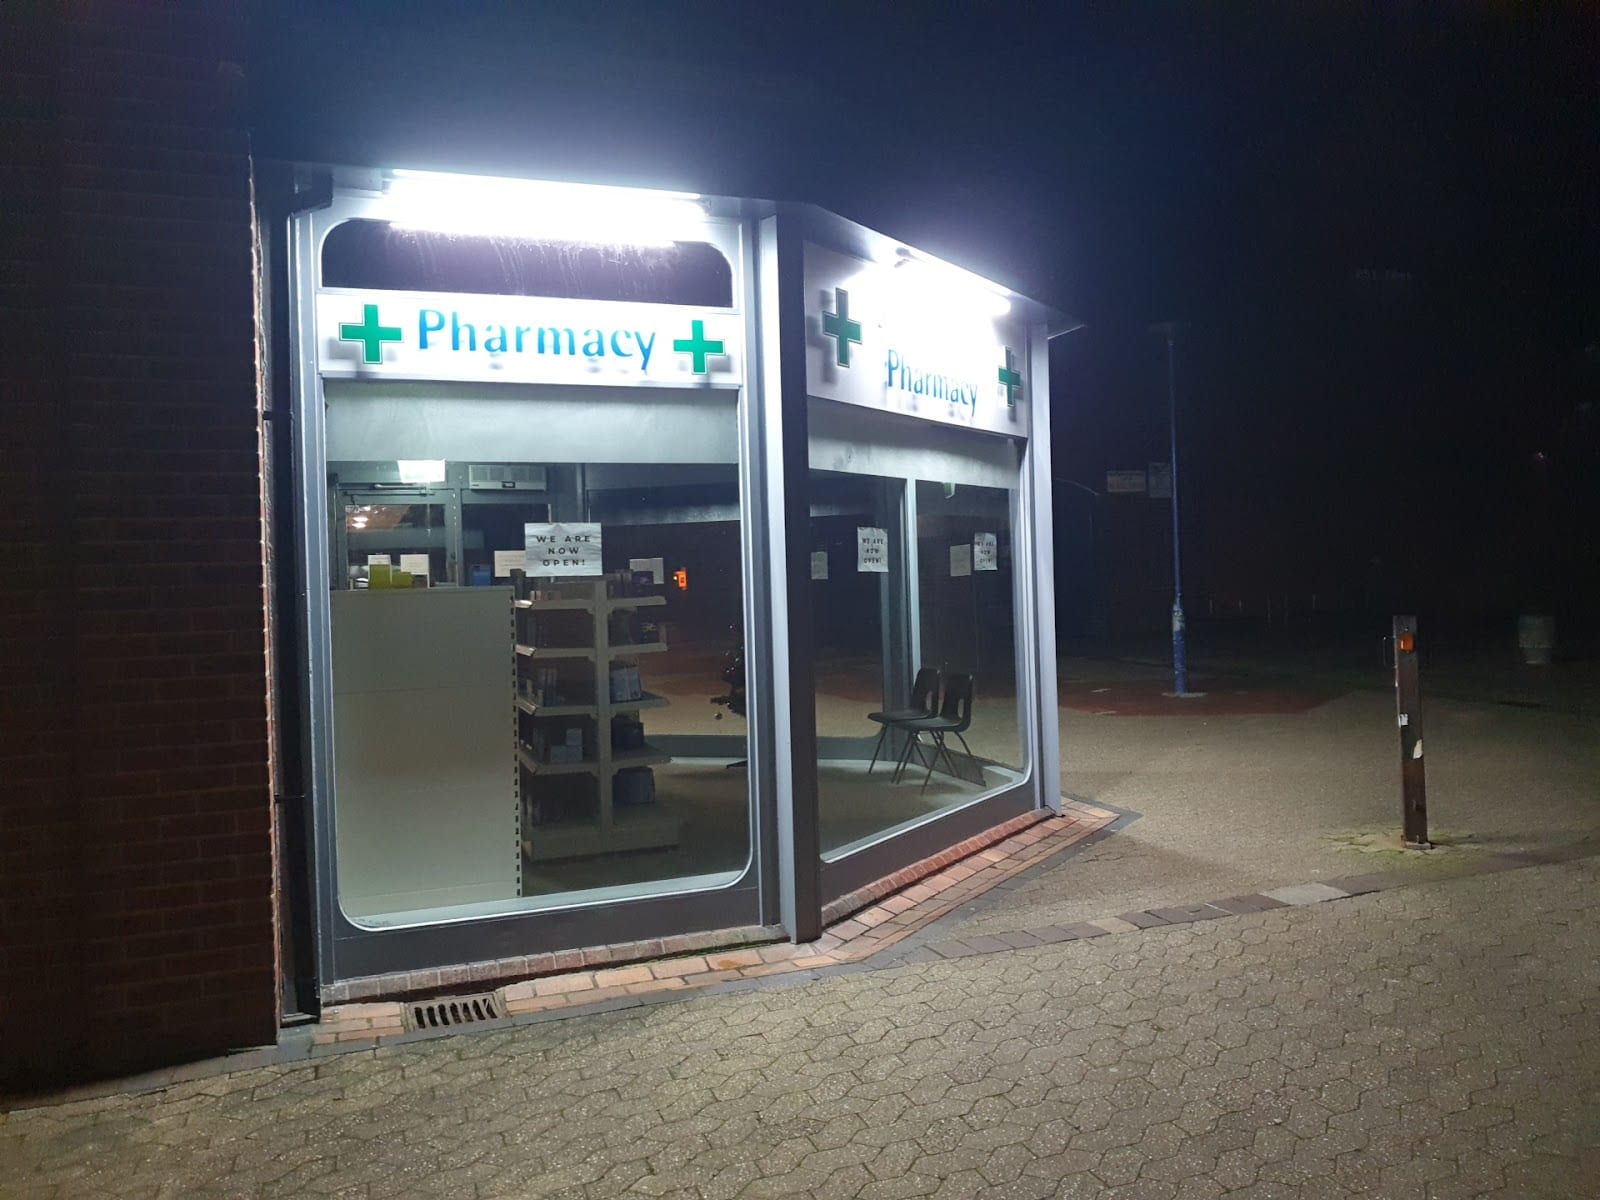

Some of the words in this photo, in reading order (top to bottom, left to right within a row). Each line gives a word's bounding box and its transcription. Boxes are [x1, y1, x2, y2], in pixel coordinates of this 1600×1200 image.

[419, 309, 655, 371] Pharmacy
[888, 349, 978, 417] Pharmacy
[536, 535, 556, 543] WE
[565, 535, 591, 543] ARE
[548, 547, 579, 555] NOW
[542, 559, 585, 567] OPEN!
